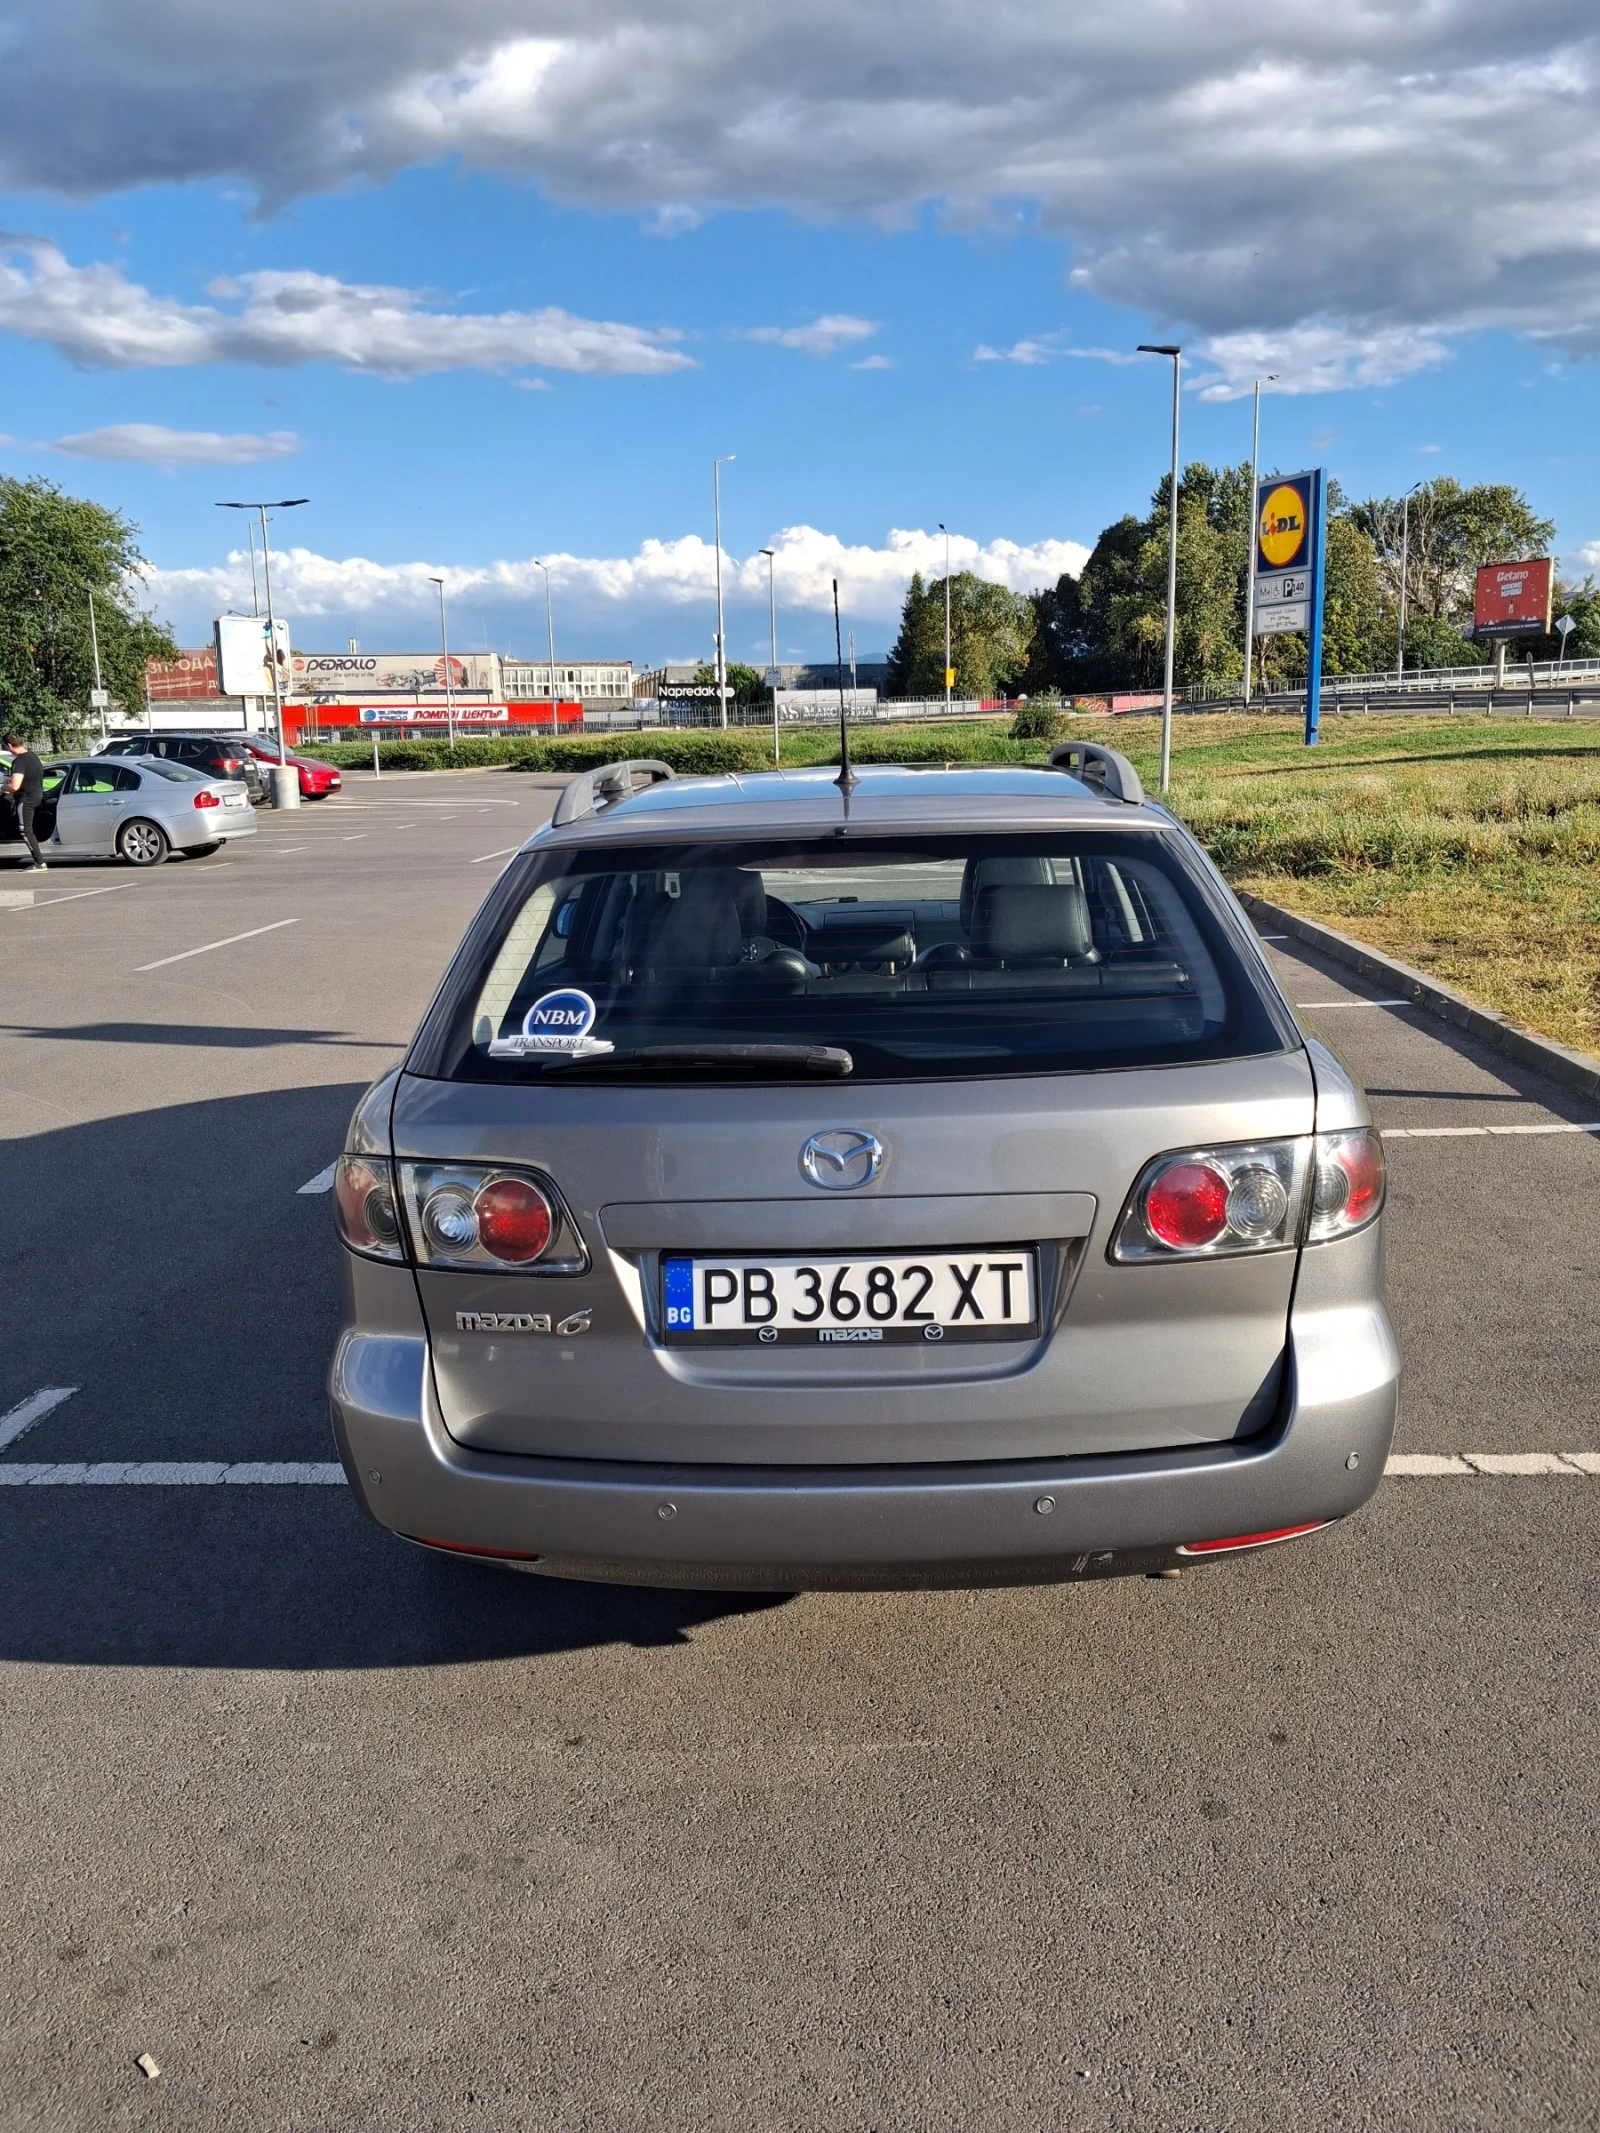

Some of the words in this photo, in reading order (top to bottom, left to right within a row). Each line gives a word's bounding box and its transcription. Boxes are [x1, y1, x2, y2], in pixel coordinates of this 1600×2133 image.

[1497, 570, 1529, 582] Betano
[306, 658, 376, 673] PEDROLLO
[659, 685, 716, 699] Napredak
[533, 1010, 587, 1026] NBM
[512, 1037, 587, 1049] TRANSPORT
[704, 1268, 778, 1324] PB
[792, 1265, 935, 1322] 3682
[949, 1263, 1023, 1320] XT
[556, 1308, 593, 1336] 6
[667, 1307, 692, 1324] BG
